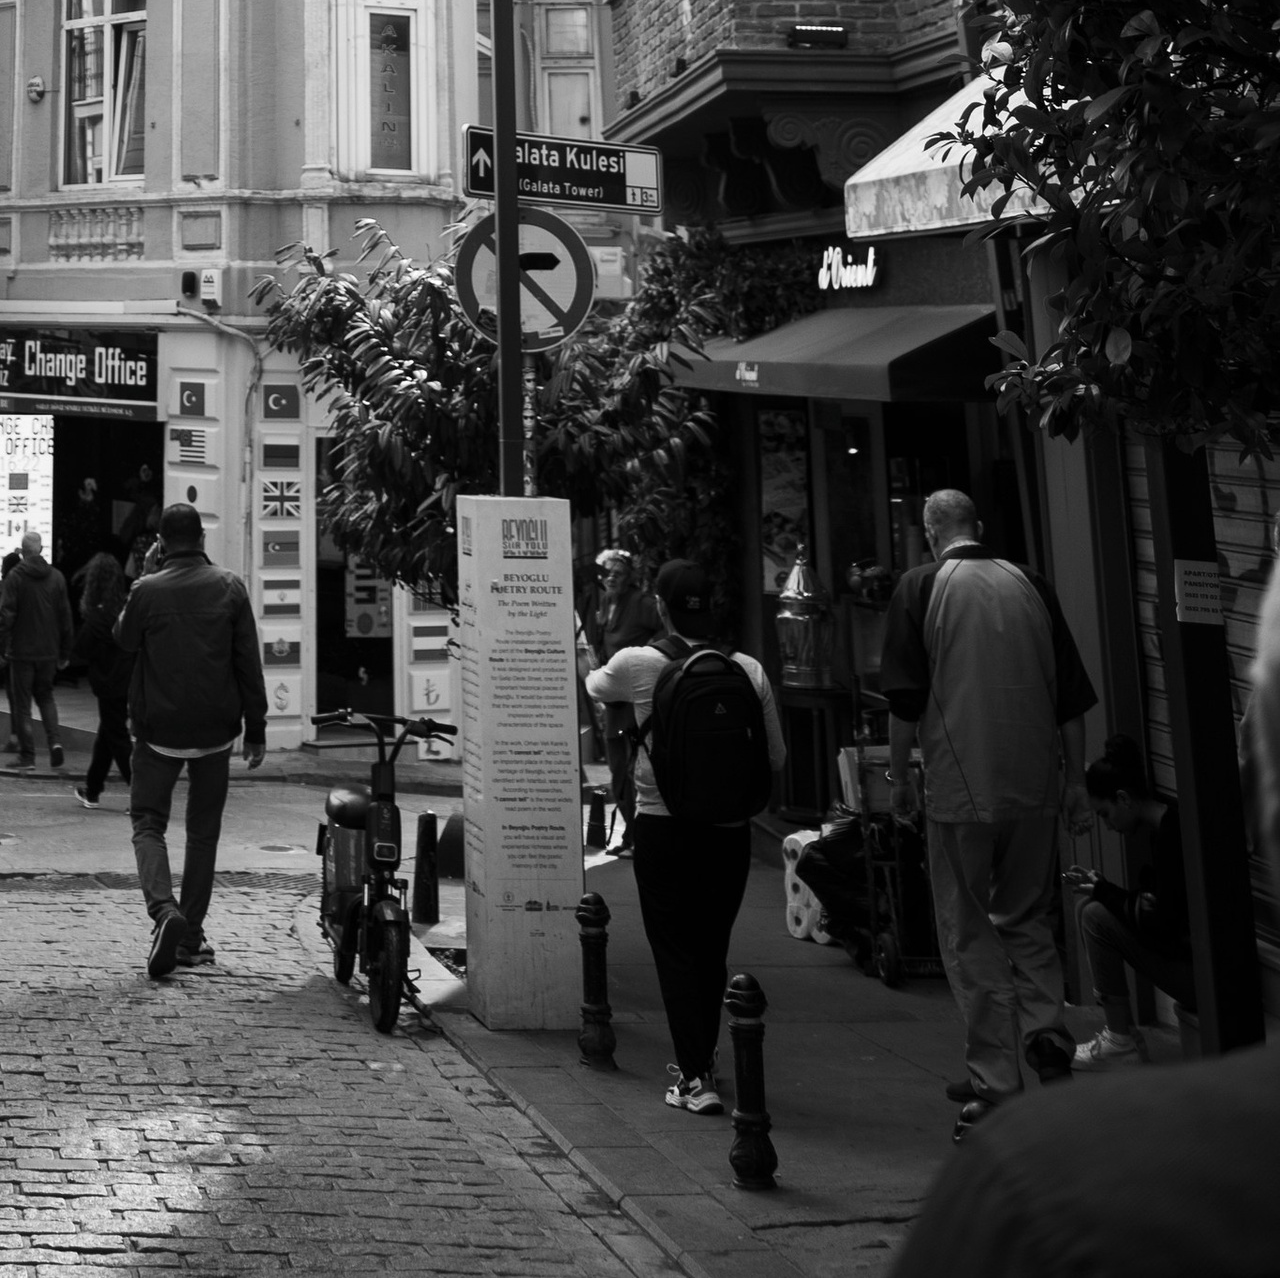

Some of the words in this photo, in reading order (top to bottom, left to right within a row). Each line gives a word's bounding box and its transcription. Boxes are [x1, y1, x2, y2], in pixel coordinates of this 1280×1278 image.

[517, 143, 560, 168] alata
[566, 146, 625, 174] Kulesi
[519, 178, 561, 194] (Galata
[563, 182, 604, 199] Tower)
[25, 340, 87, 386] Change
[94, 346, 147, 386] Office
[490, 585, 528, 594] POETRY
[530, 586, 563, 595] ROUTE
[507, 610, 516, 618] by
[530, 610, 548, 618] Light
